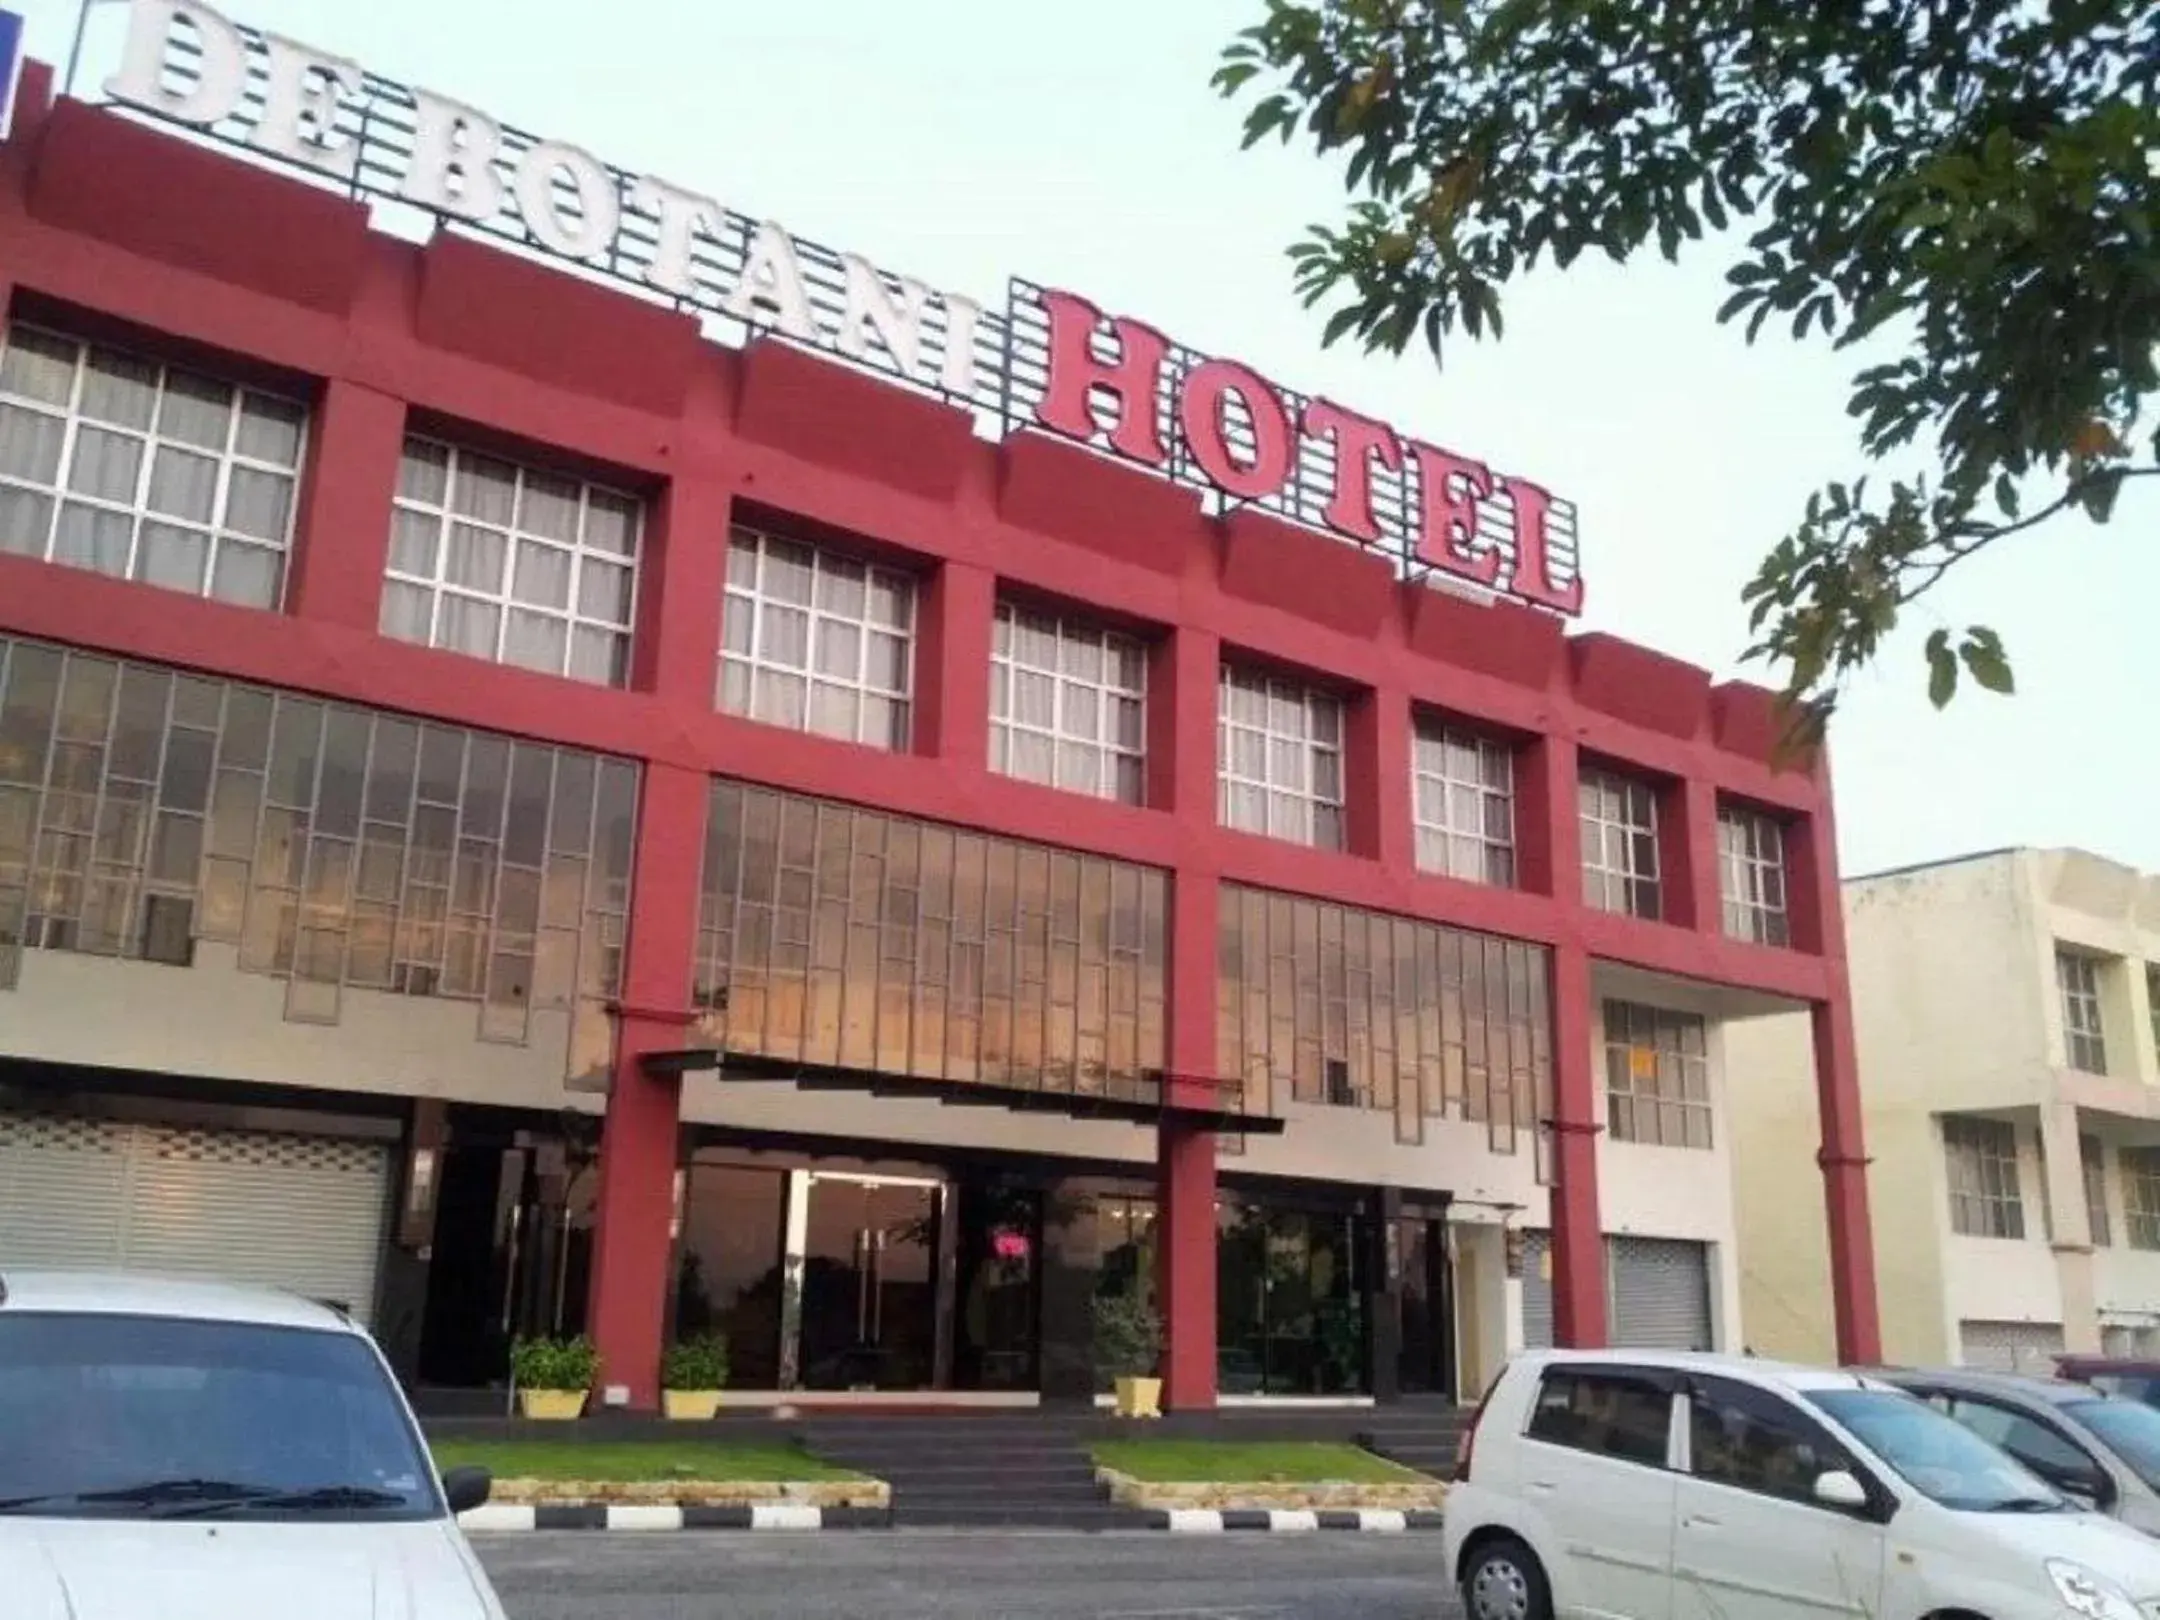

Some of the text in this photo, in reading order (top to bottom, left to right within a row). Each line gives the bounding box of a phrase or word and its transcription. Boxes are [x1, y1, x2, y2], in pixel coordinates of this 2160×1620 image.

[102, 0, 1585, 617] DE BOTANI HOTEL
